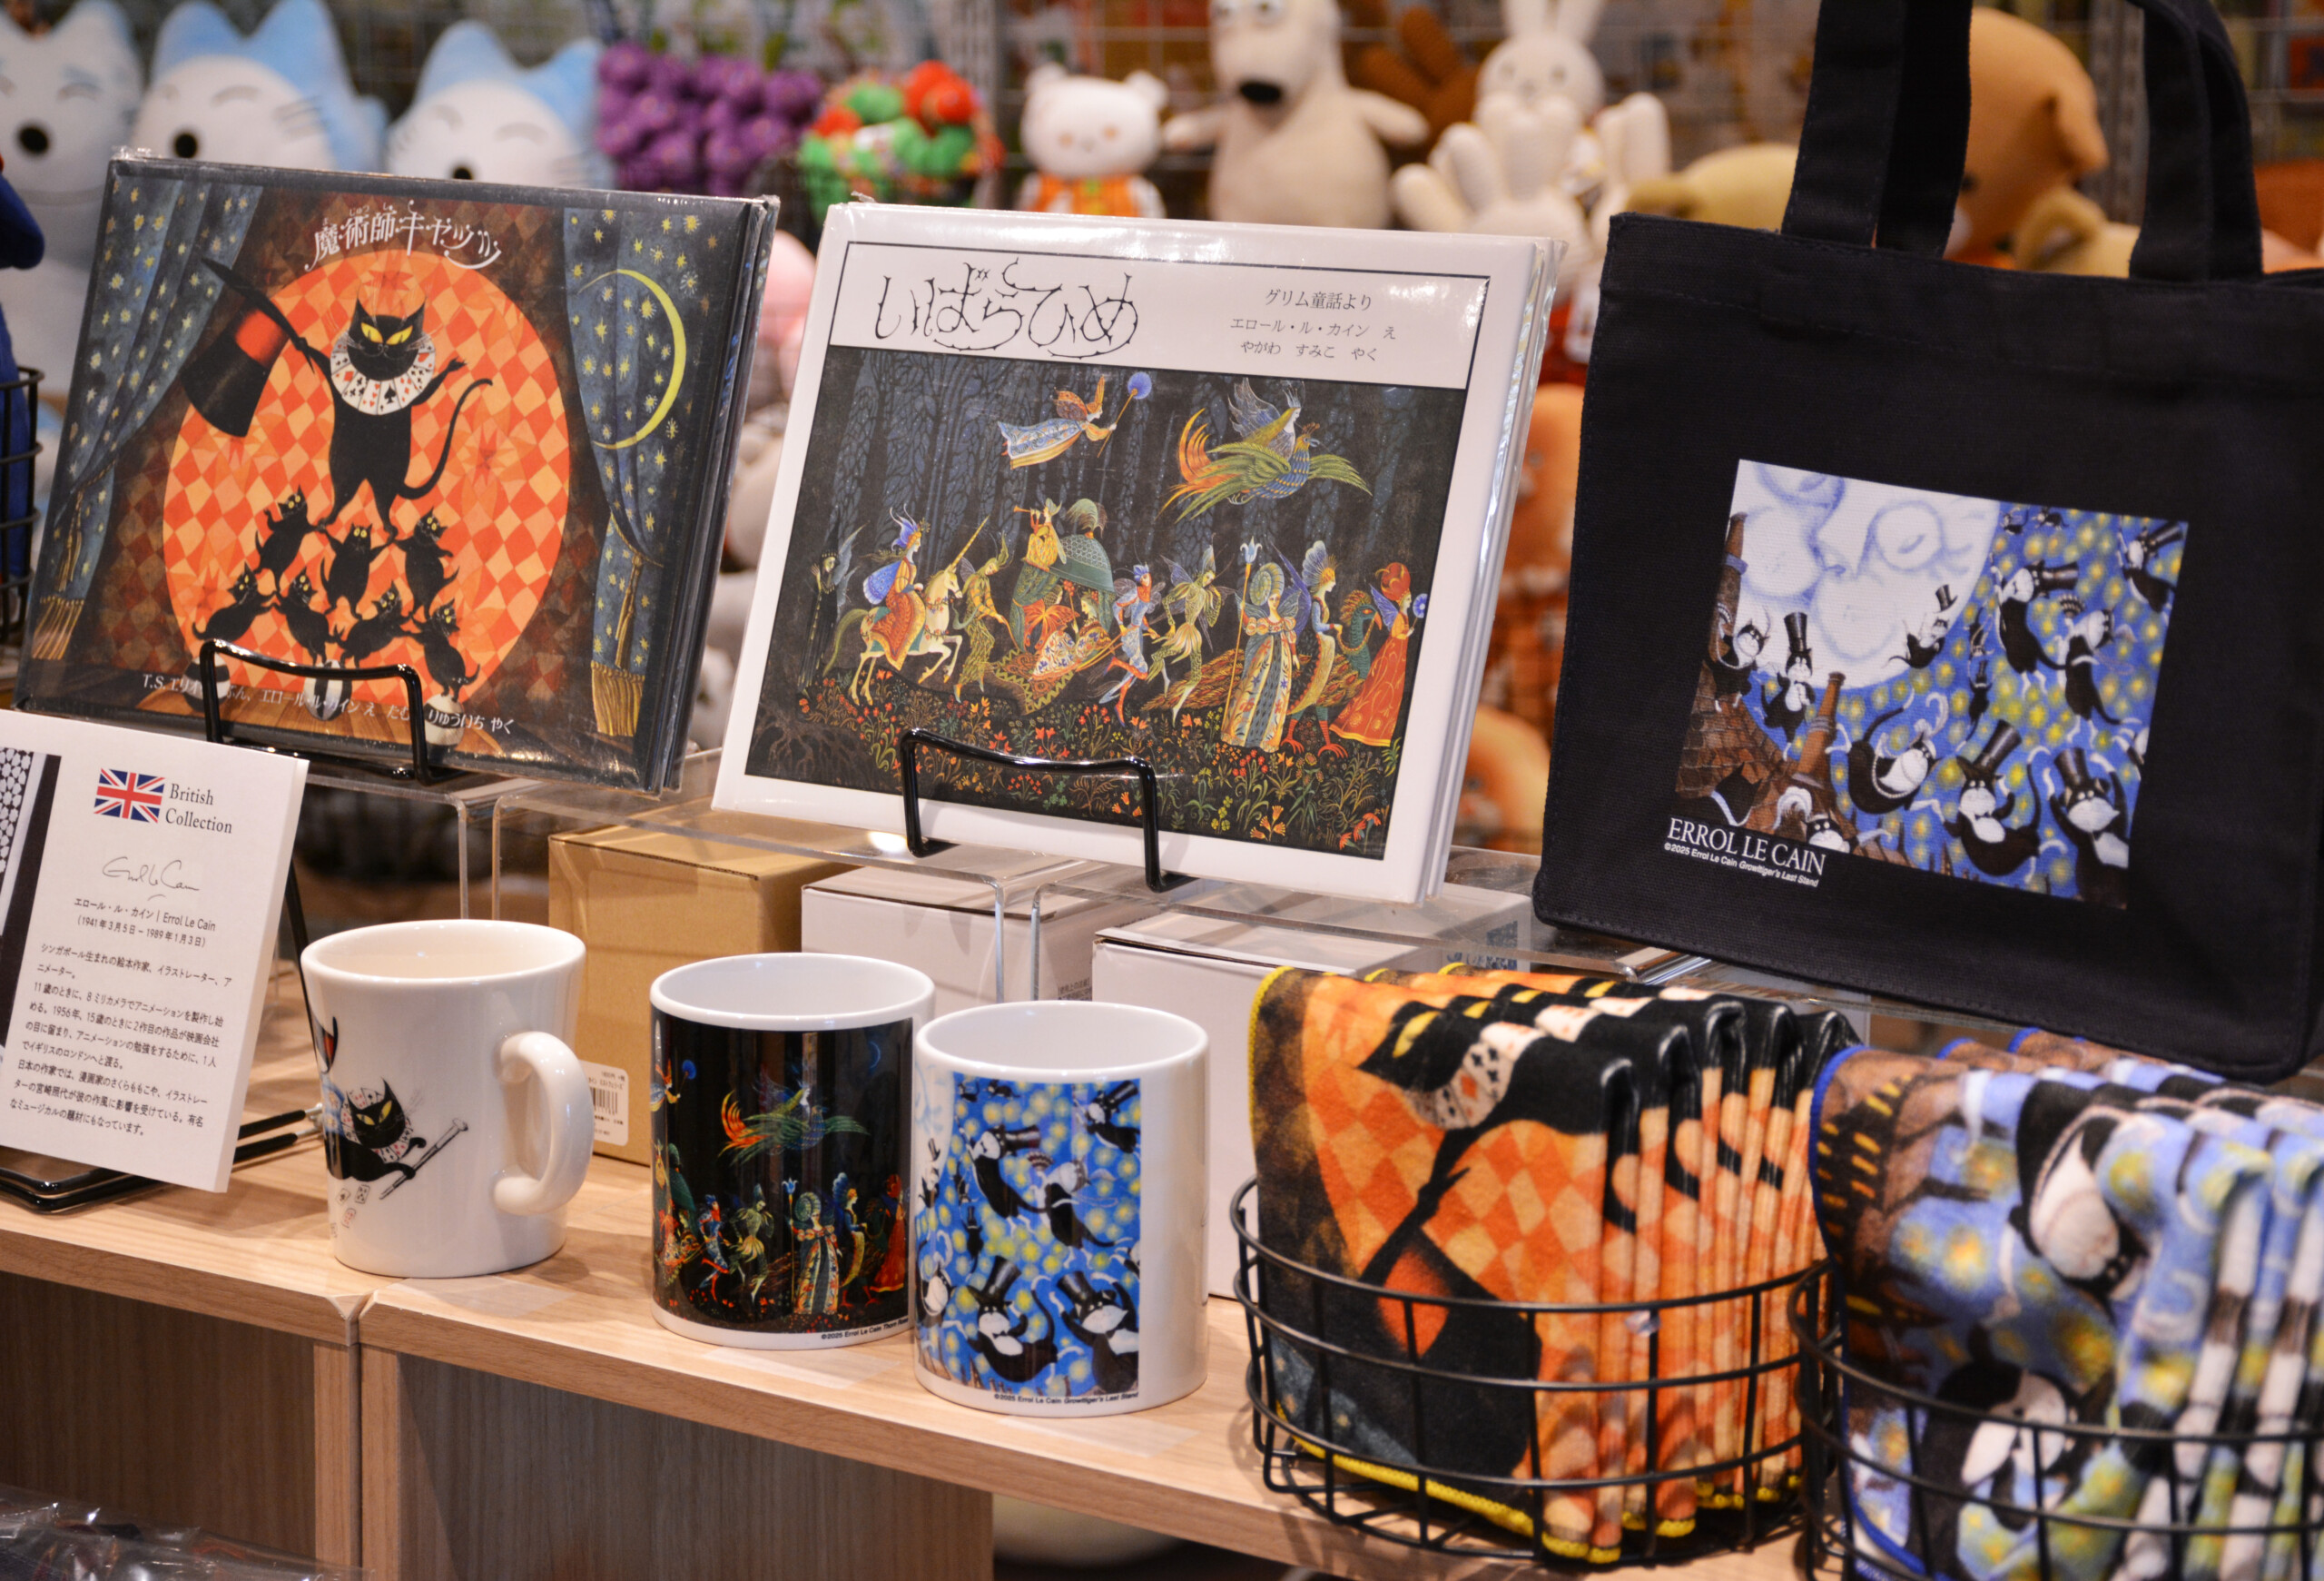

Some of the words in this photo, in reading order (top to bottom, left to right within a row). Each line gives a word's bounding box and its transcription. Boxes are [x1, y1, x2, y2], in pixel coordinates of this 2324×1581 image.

[304, 199, 501, 272] 魔術師キャッツ
[874, 256, 1138, 360] いばらひめ
[1265, 289, 1372, 311] グリム童話より
[1230, 318, 1370, 338] エロール・ル・カイン
[1383, 326, 1396, 340] え
[1241, 341, 1281, 355] やがわ
[1295, 343, 1335, 359] すみこ
[1351, 347, 1377, 361] やく
[490, 717, 515, 735] やく
[170, 783, 213, 805] British
[165, 807, 232, 834] Collection
[1667, 817, 1738, 855] ERROL
[1741, 835, 1768, 862] LE
[1771, 843, 1827, 876] CAIN
[1663, 842, 1690, 855] ©2025
[1690, 848, 1710, 862] Errol
[1709, 854, 1720, 863] Le
[1720, 855, 1738, 868] Cain
[1780, 870, 1797, 883] Last
[1797, 874, 1819, 888] Stand
[162, 912, 182, 924] Errol
[184, 915, 194, 928] Le
[197, 918, 216, 932] Cain
[37, 963, 75, 979] ニメーター。
[22, 1041, 123, 1070] でイギリスのロンドンへと渡る。
[844, 1329, 860, 1338] Errol
[994, 1394, 1016, 1402] ©2025
[1105, 1394, 1119, 1402] Last
[1120, 1391, 1138, 1400] Stand
